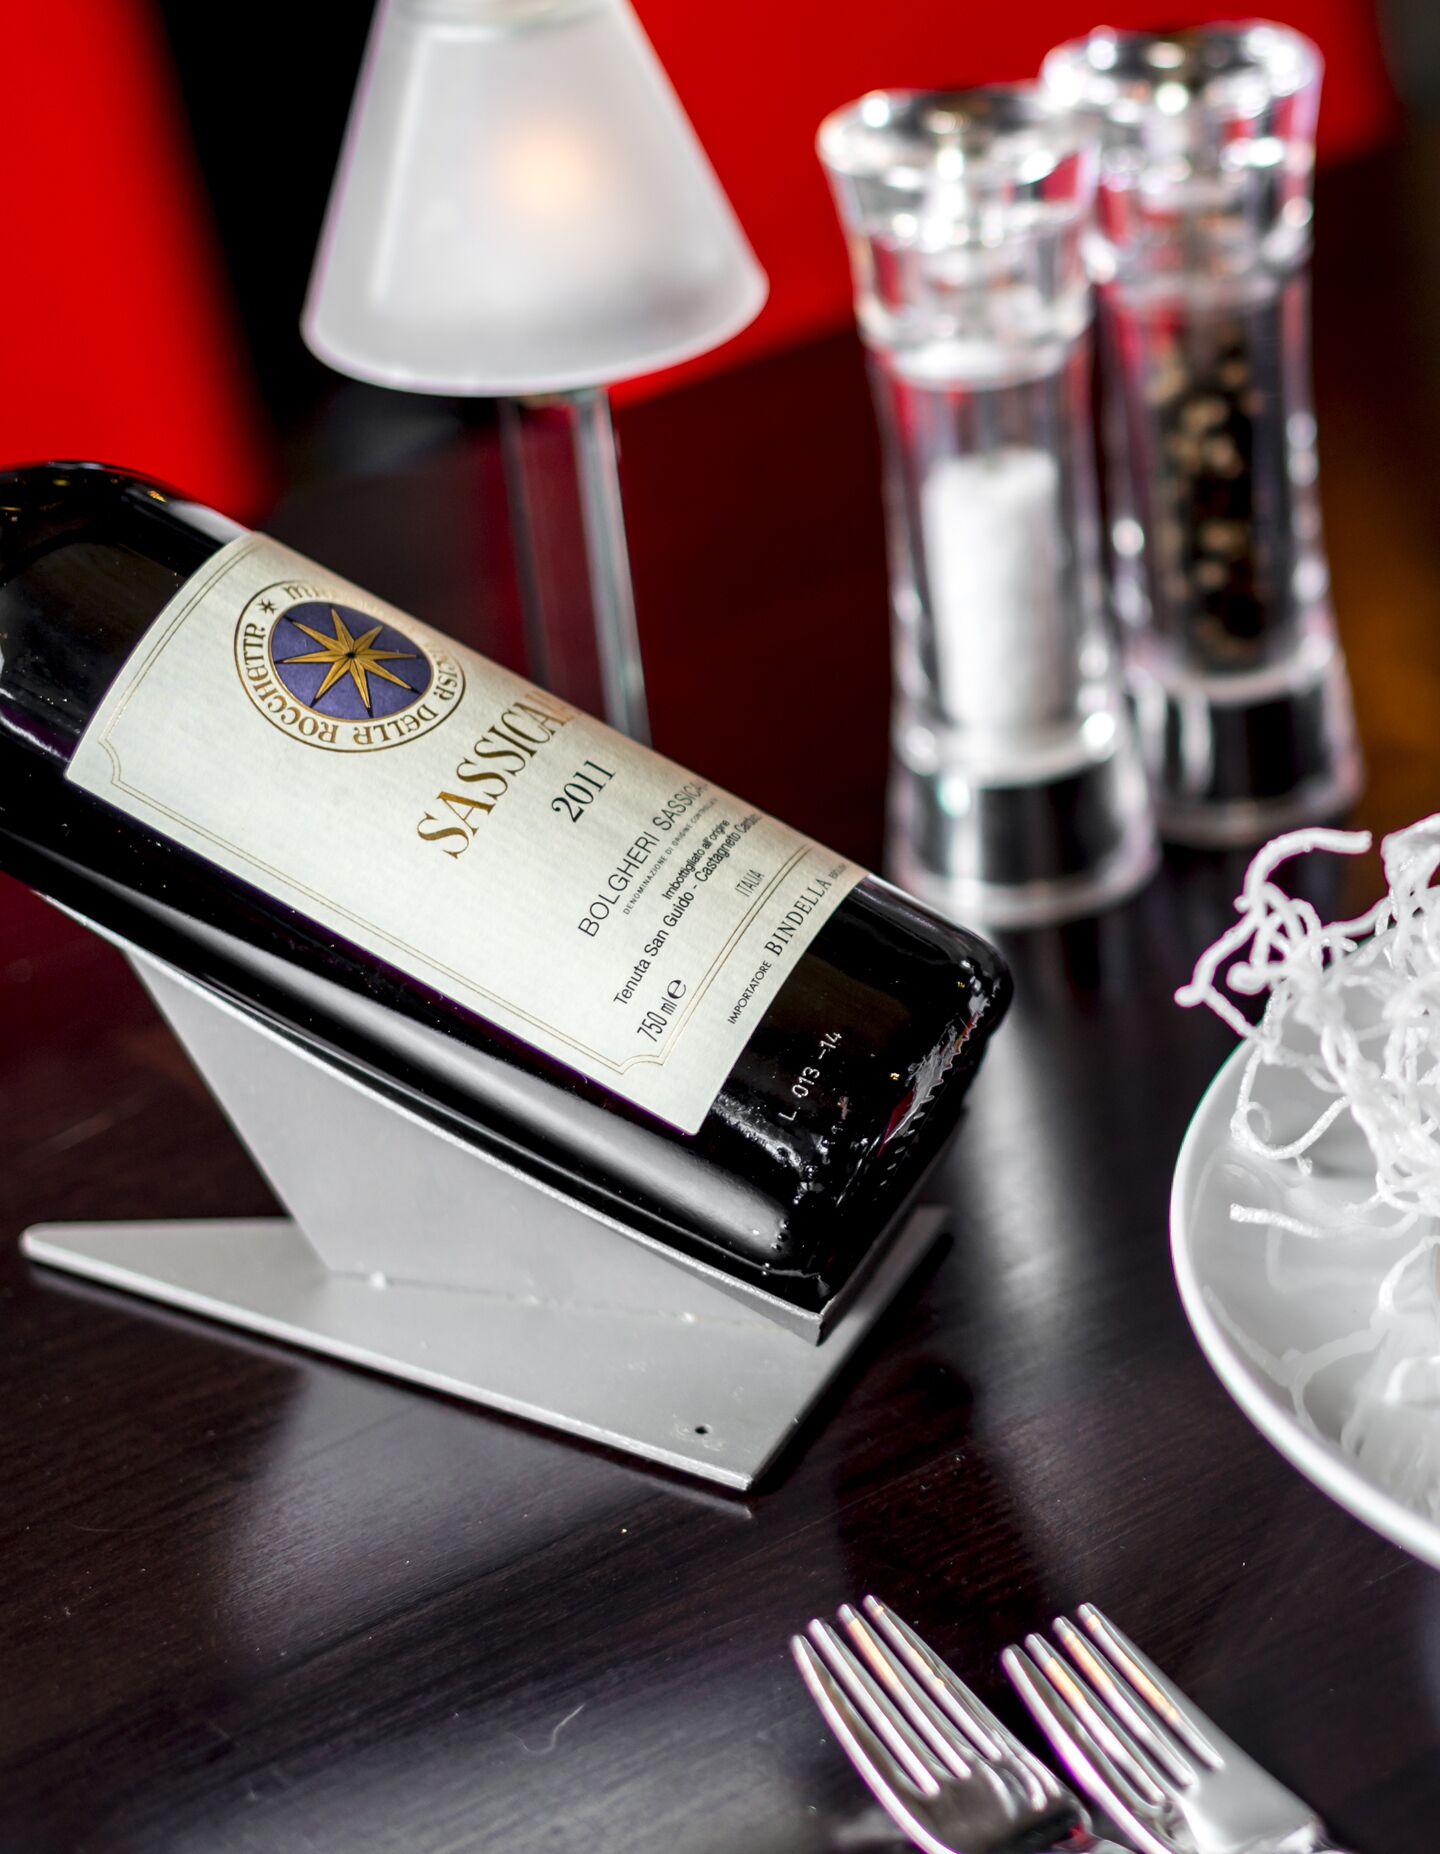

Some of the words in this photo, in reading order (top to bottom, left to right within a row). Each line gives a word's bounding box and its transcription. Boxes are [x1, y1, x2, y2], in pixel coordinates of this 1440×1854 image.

[416, 689, 582, 860] SASSICA
[551, 760, 616, 823] 2011
[578, 831, 660, 937] BOLGHERI
[622, 855, 668, 915] DENOMINAZIONE
[661, 848, 706, 900] Imbottigliato
[734, 868, 766, 898] ITALIA
[613, 958, 652, 1005] Tenuta
[643, 928, 670, 957] San
[662, 890, 695, 928] Guido
[694, 831, 742, 883] Castagneto
[727, 959, 773, 1026] IMPORTATORE
[763, 877, 833, 957] BINDELLA
[636, 1011, 669, 1043] 750
[791, 1066, 821, 1099] 013
